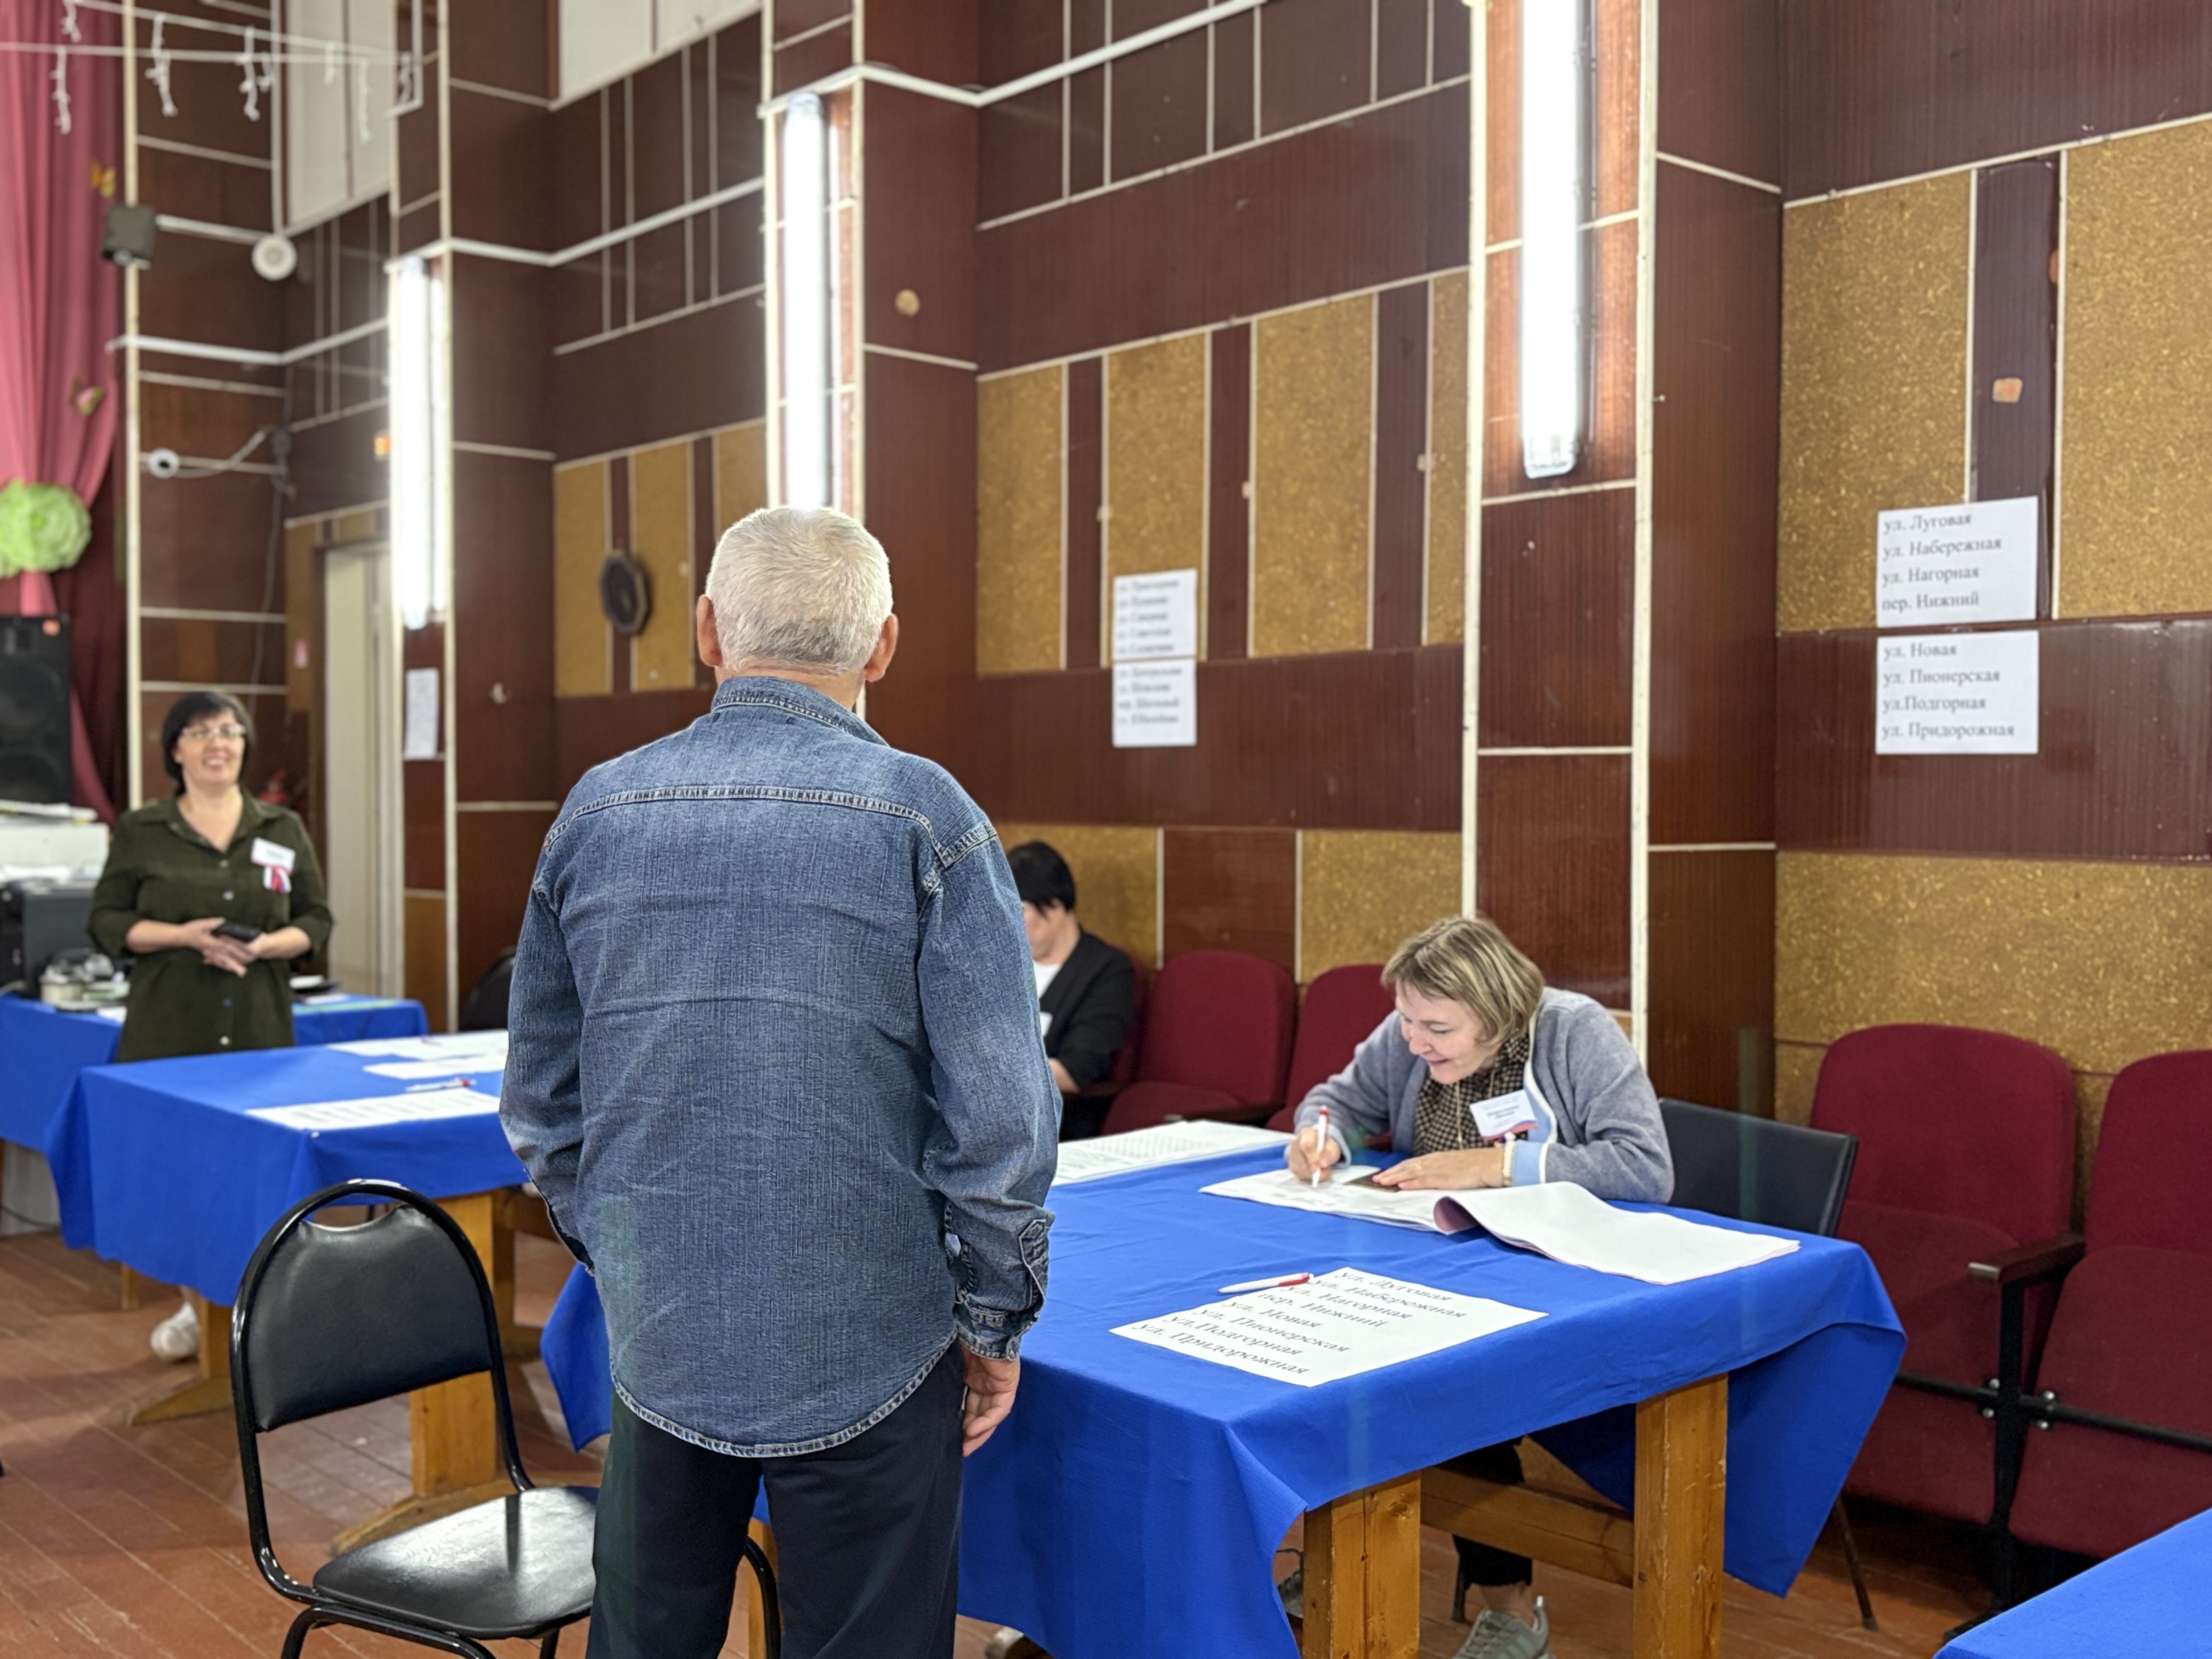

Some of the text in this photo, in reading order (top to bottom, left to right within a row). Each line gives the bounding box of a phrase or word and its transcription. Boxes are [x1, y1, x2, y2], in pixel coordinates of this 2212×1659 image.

[1910, 512, 1972, 533] Луговая
[1910, 538, 2002, 557] Набережная
[1908, 567, 1980, 583] Нагорная
[1917, 591, 1979, 609] Нижний
[1910, 643, 1957, 657] Новая
[1910, 669, 2000, 687] Пионерская
[1908, 722, 2015, 741] Придорожная
[1369, 1279, 1453, 1301] Луговая
[1318, 1293, 1413, 1319] Нагорная
[1345, 1287, 1467, 1318] Набережная
[1260, 1309, 1322, 1328] Новая
[1300, 1302, 1389, 1328] Нижний
[1231, 1317, 1351, 1352] Пионерская
[1169, 1332, 1310, 1374] Придорожная
